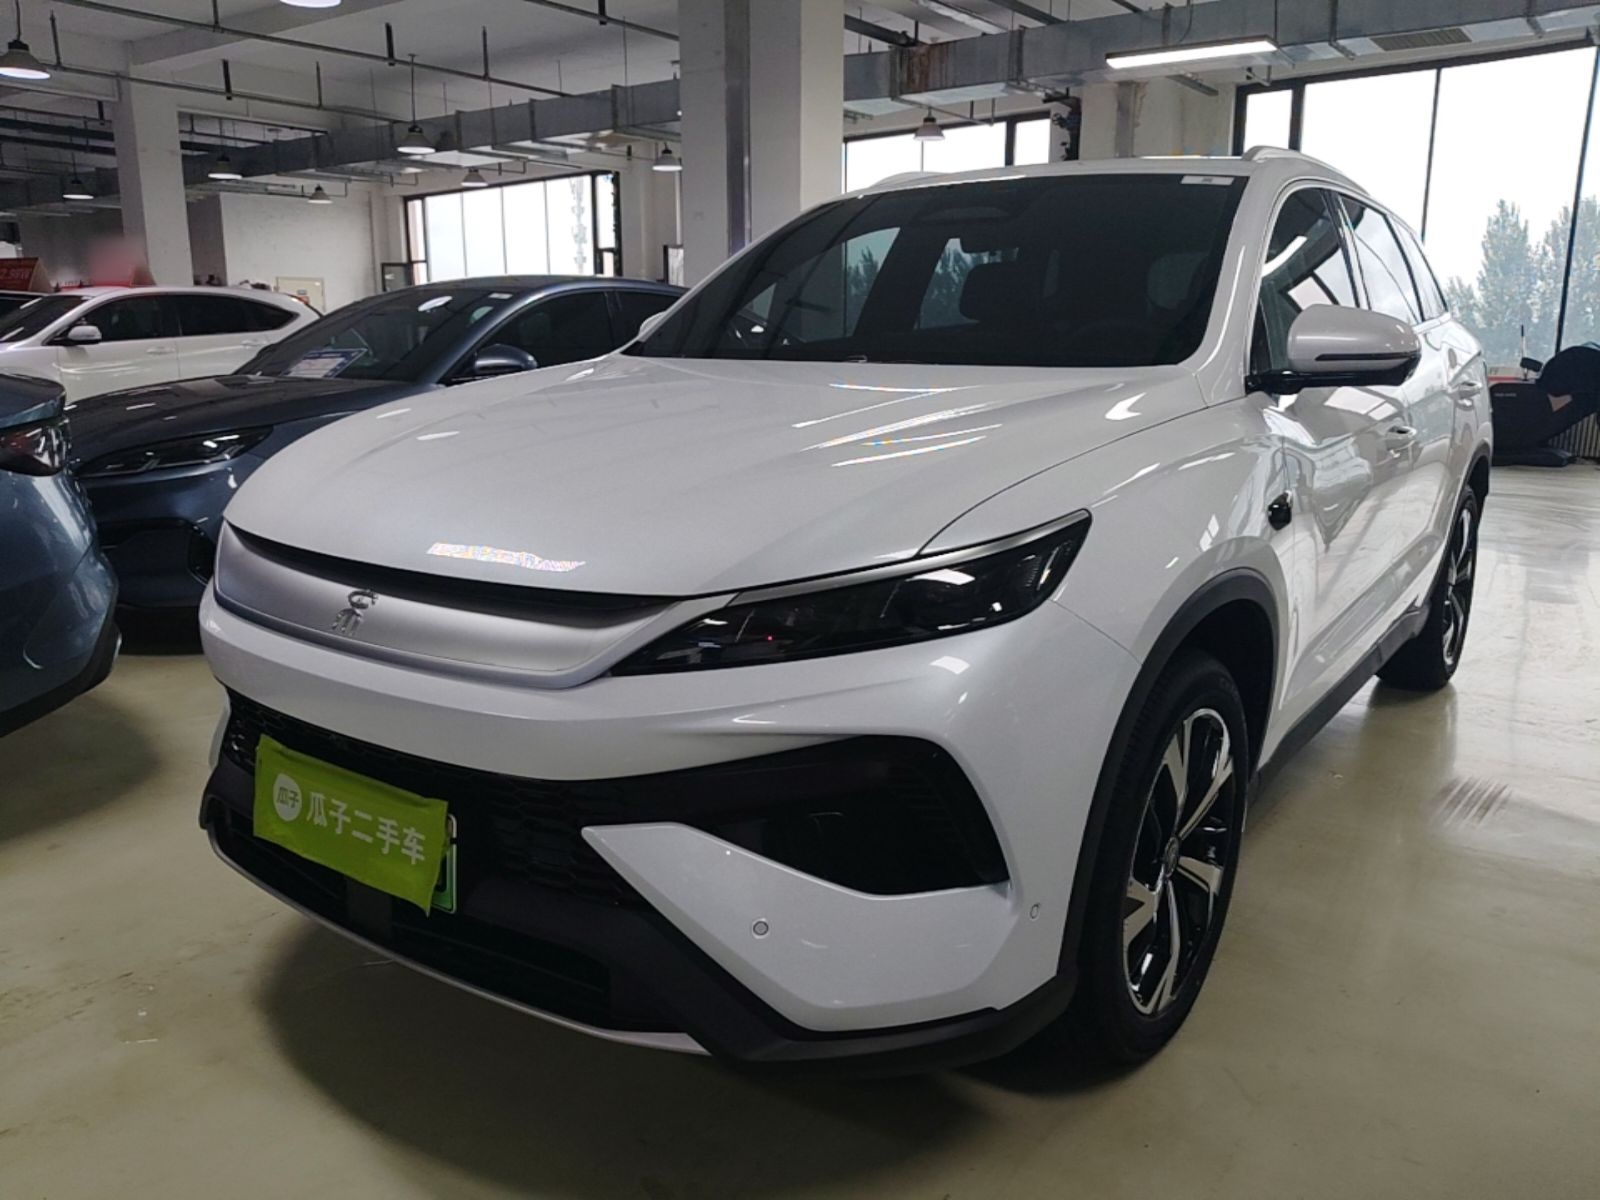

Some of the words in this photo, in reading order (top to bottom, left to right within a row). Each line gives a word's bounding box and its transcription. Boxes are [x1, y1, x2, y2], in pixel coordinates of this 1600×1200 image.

[277, 786, 299, 808] 瓜子
[306, 792, 425, 865] 瓜子二手车
